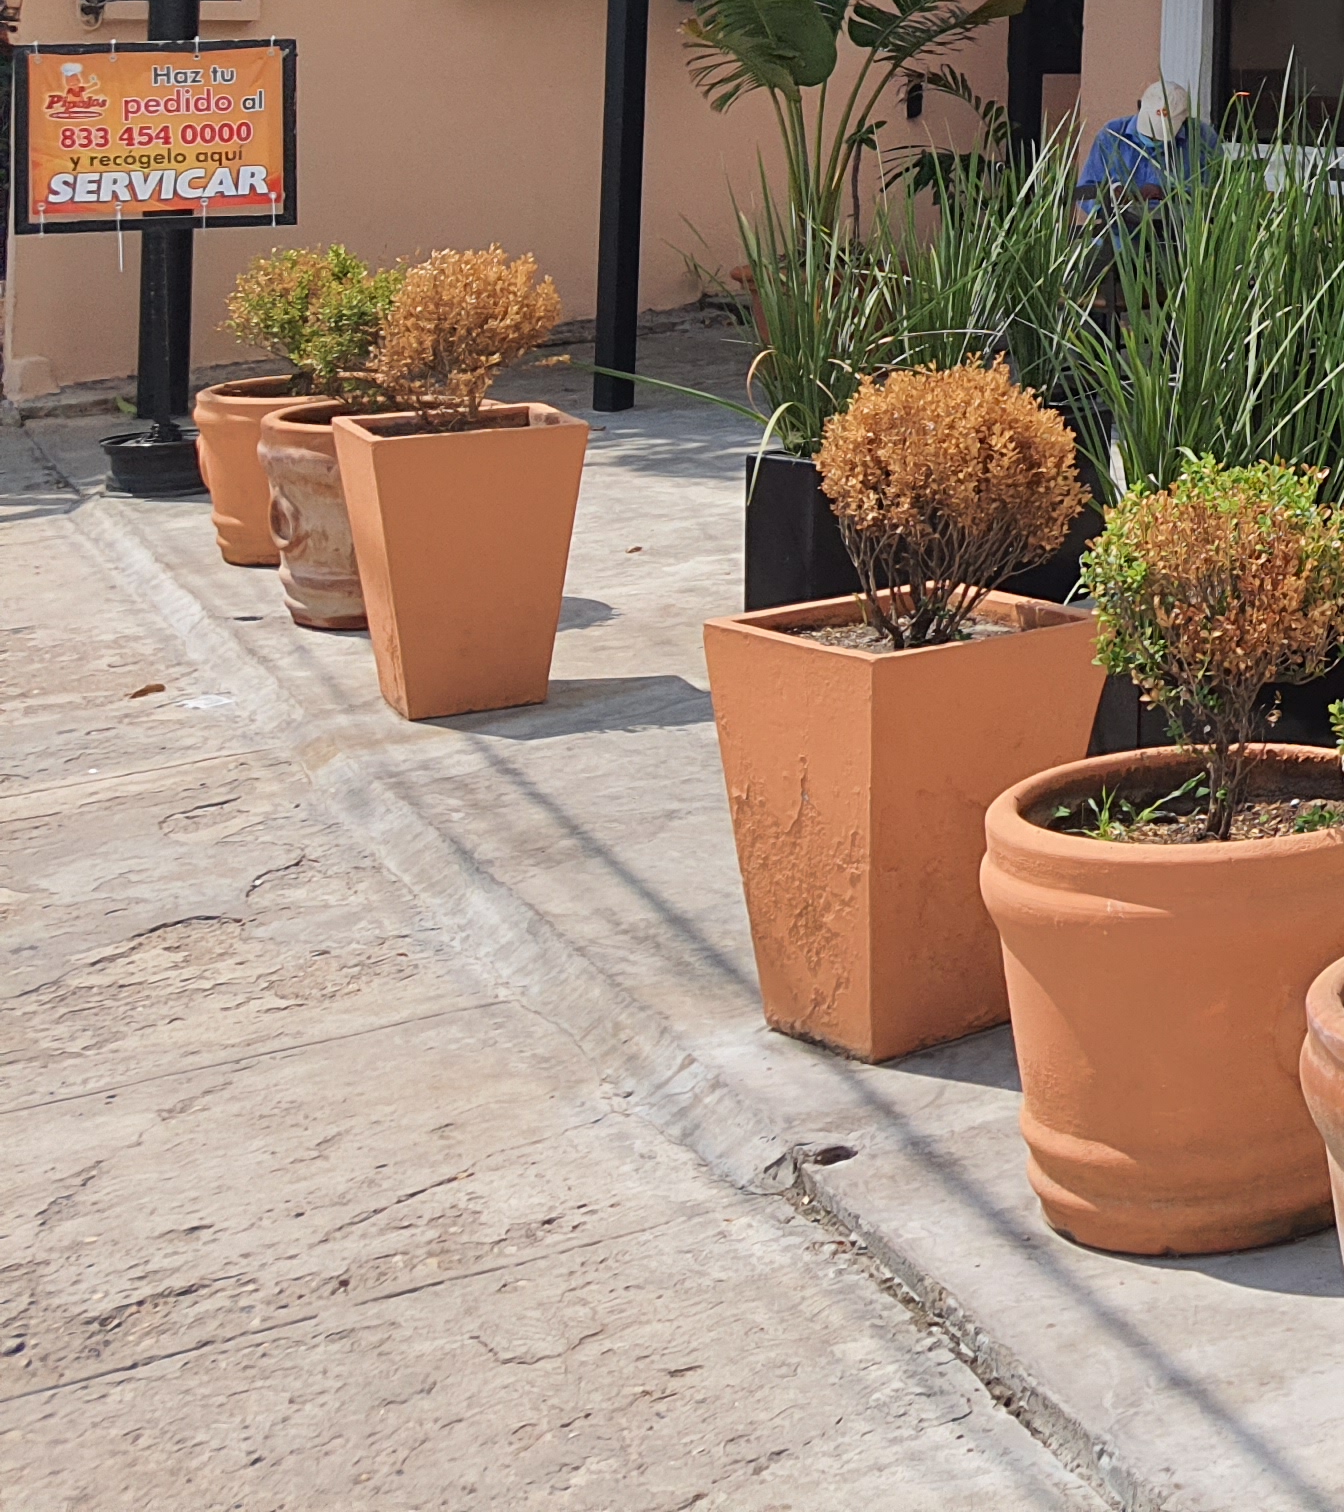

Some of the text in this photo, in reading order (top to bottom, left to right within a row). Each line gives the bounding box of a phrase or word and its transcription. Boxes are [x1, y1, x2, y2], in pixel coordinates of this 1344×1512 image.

[152, 65, 236, 86] Haz tu
[122, 88, 264, 121] pedido al
[60, 121, 252, 149] 833 454 0000
[70, 145, 244, 171] y recógelo aquí
[48, 165, 269, 204] SERVICAR
